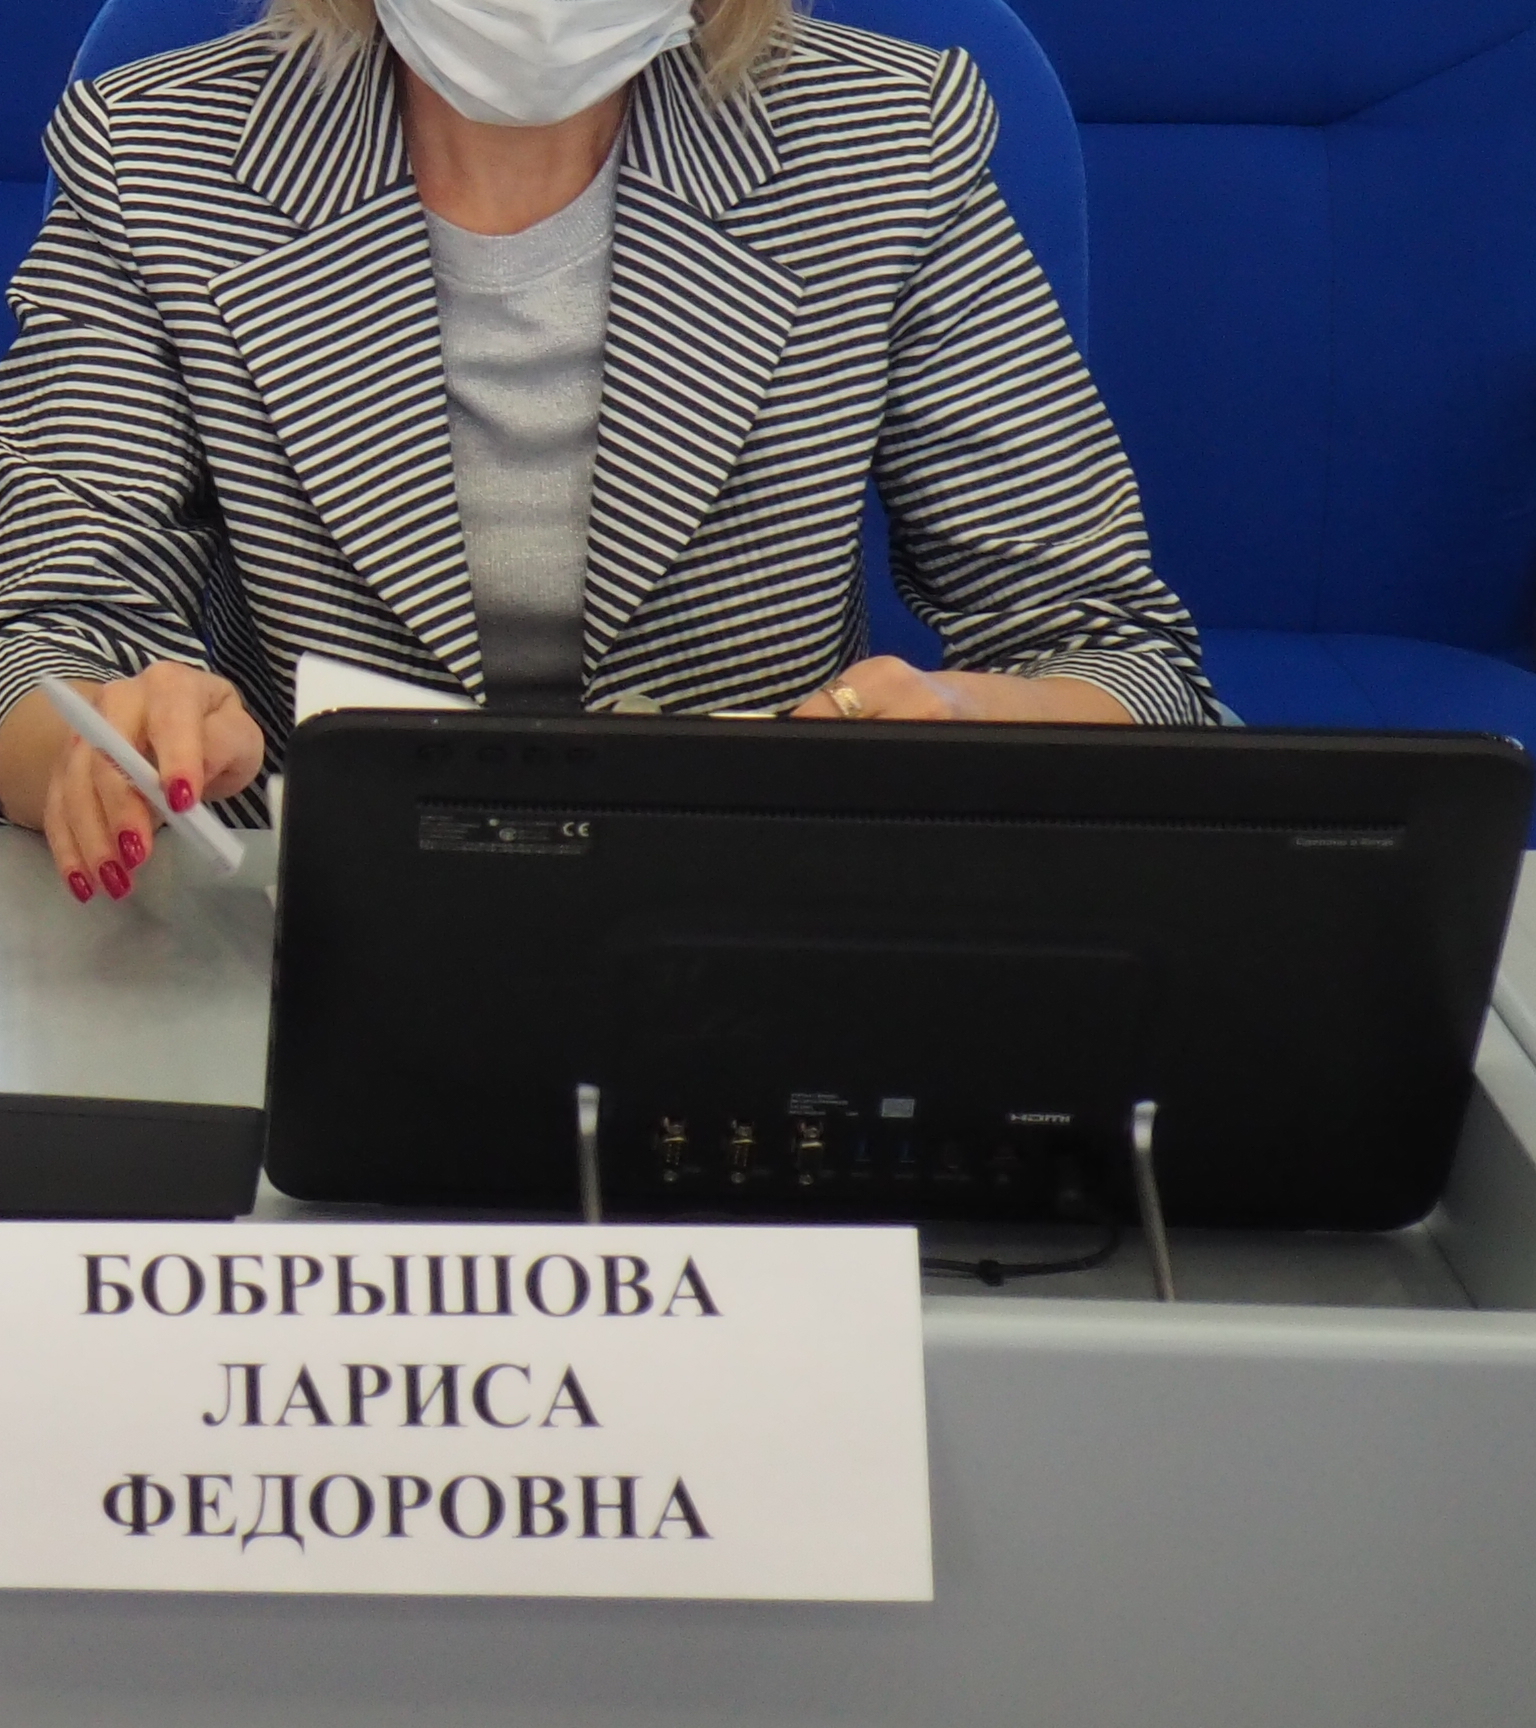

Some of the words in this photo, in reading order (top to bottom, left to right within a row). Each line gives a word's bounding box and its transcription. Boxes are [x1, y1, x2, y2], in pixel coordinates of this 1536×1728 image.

[82, 1253, 723, 1317] БОБРЫШОВА
[202, 1363, 602, 1428] ЛАРИСА
[102, 1473, 714, 1553] ФЕДОРОВНА
